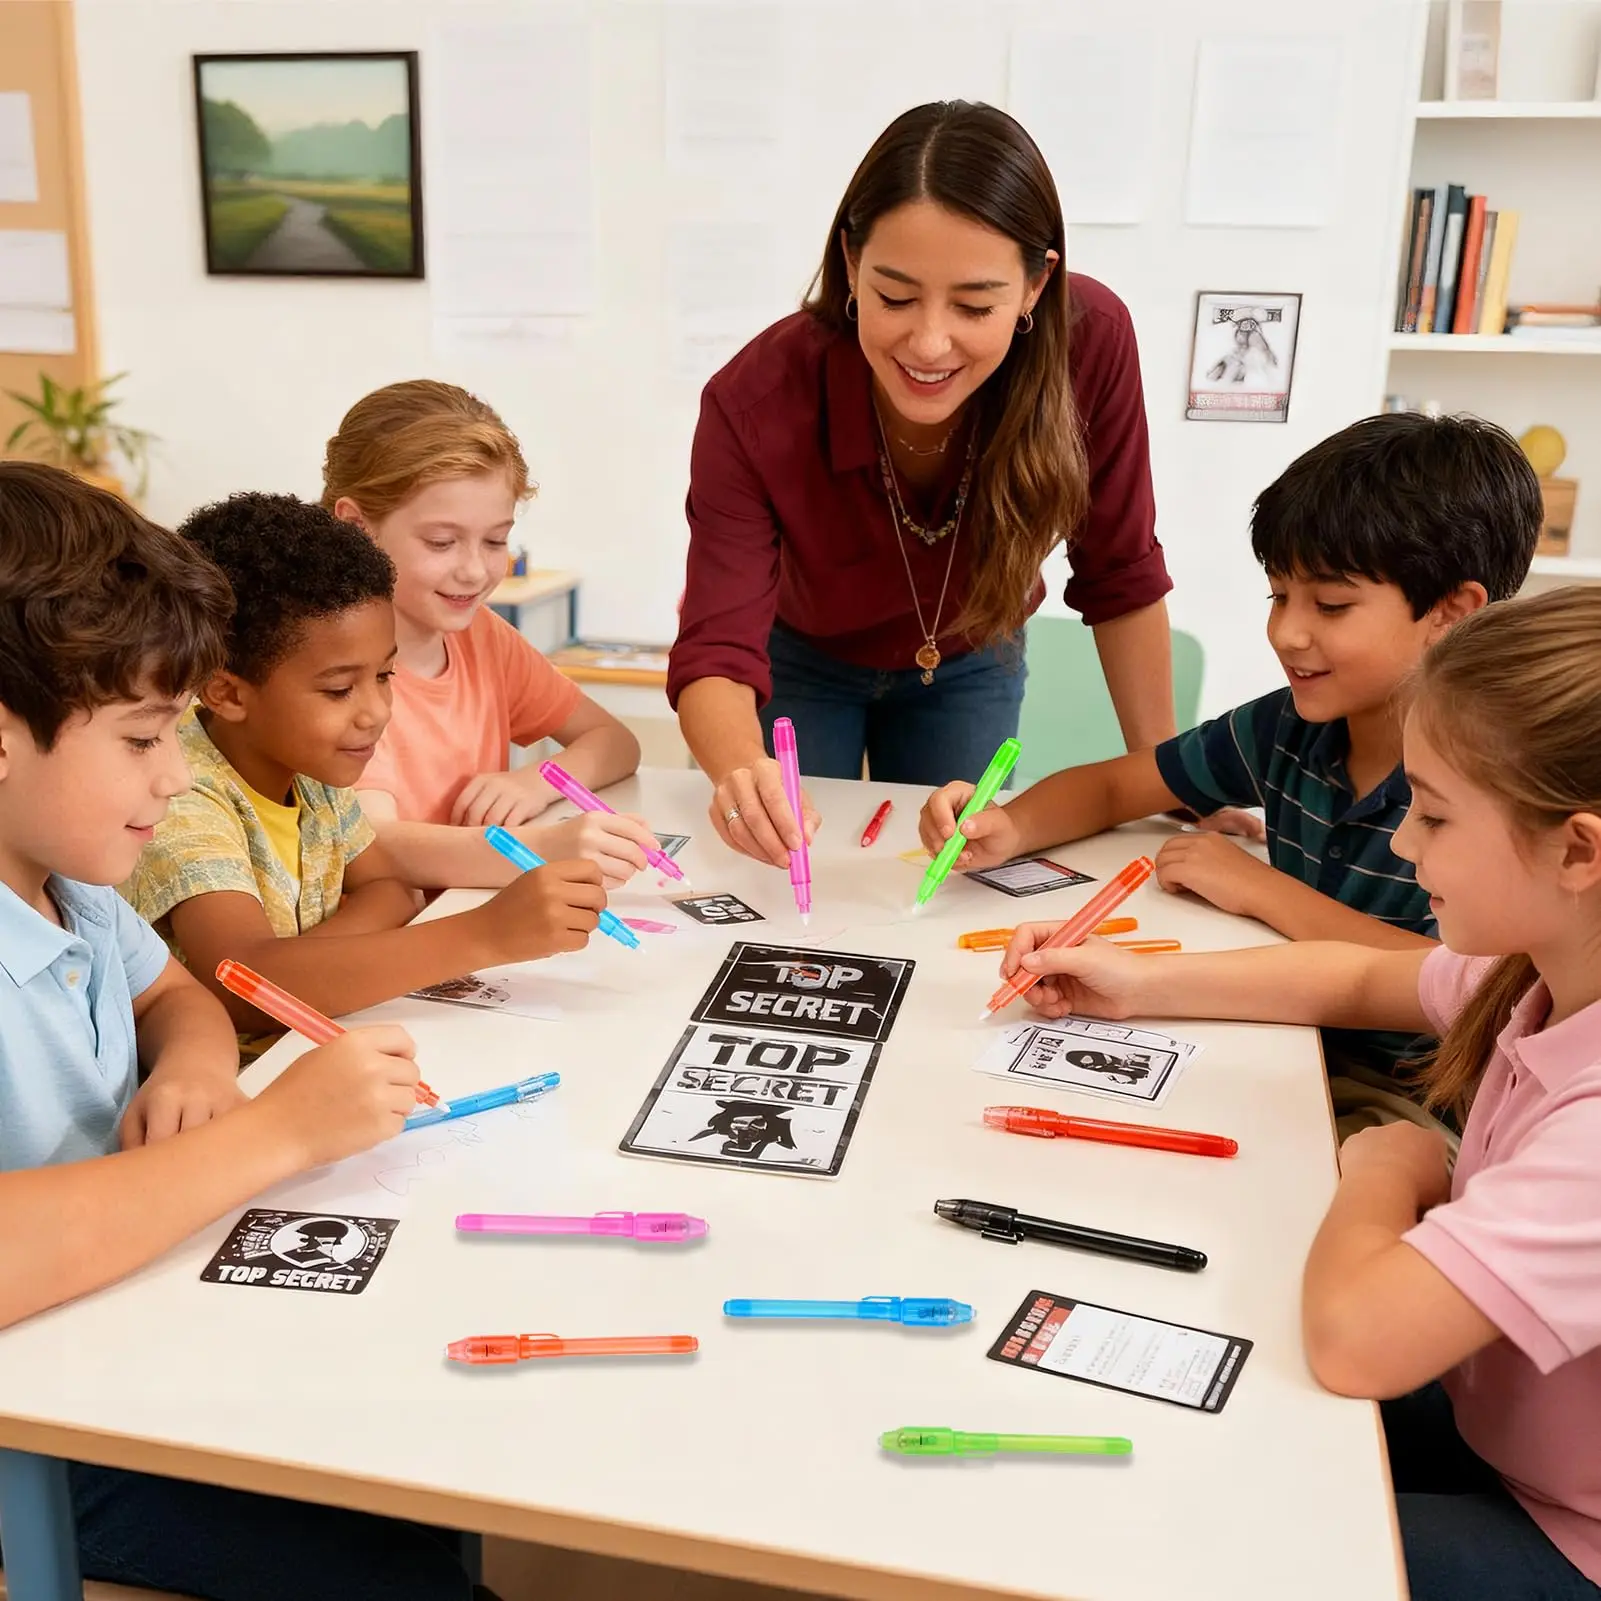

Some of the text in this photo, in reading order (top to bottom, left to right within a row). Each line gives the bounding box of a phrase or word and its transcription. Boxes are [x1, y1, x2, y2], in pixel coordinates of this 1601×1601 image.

[774, 962, 864, 990] TOP
[726, 991, 875, 1025] SECRET
[708, 1033, 851, 1074] TOP
[677, 1069, 848, 1106] SECRET
[218, 1265, 363, 1291] TOP SECRET
